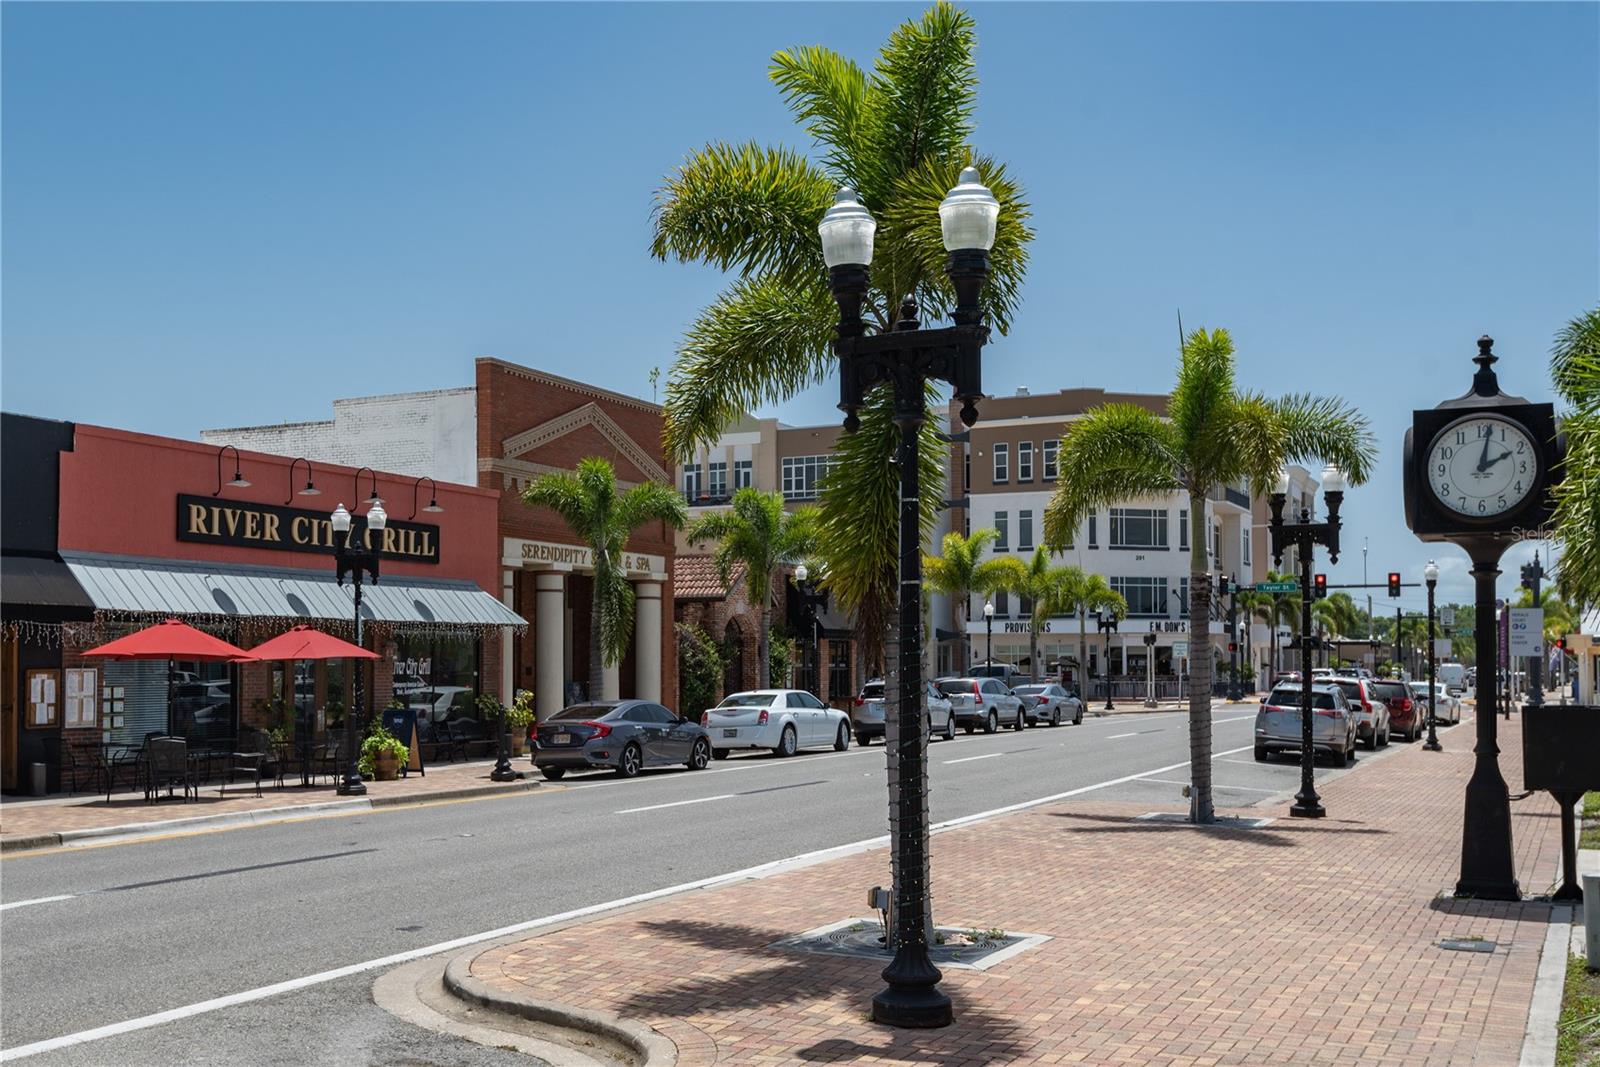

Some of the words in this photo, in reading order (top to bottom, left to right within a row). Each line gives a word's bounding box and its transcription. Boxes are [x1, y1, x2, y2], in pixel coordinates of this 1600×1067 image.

[1477, 425, 1490, 438] 12
[1501, 429, 1505, 441] 1
[1456, 432, 1465, 445] 11
[1441, 447, 1453, 460] 10
[1517, 441, 1525, 454] 2
[1438, 464, 1446, 477] 9
[1520, 461, 1527, 473] 3
[1441, 483, 1450, 496] 8
[1514, 481, 1522, 494] 4
[1459, 497, 1468, 510] 7
[1478, 500, 1486, 512] 6
[1498, 495, 1506, 509] 5
[187, 503, 281, 542] RIVER
[291, 516, 356, 550] CITY
[521, 543, 587, 564] SERENDIPITY
[625, 555, 632, 569] &
[636, 556, 651, 571] SPA
[1005, 622, 1051, 632] PROVISNS
[1164, 621, 1186, 633] DON'S
